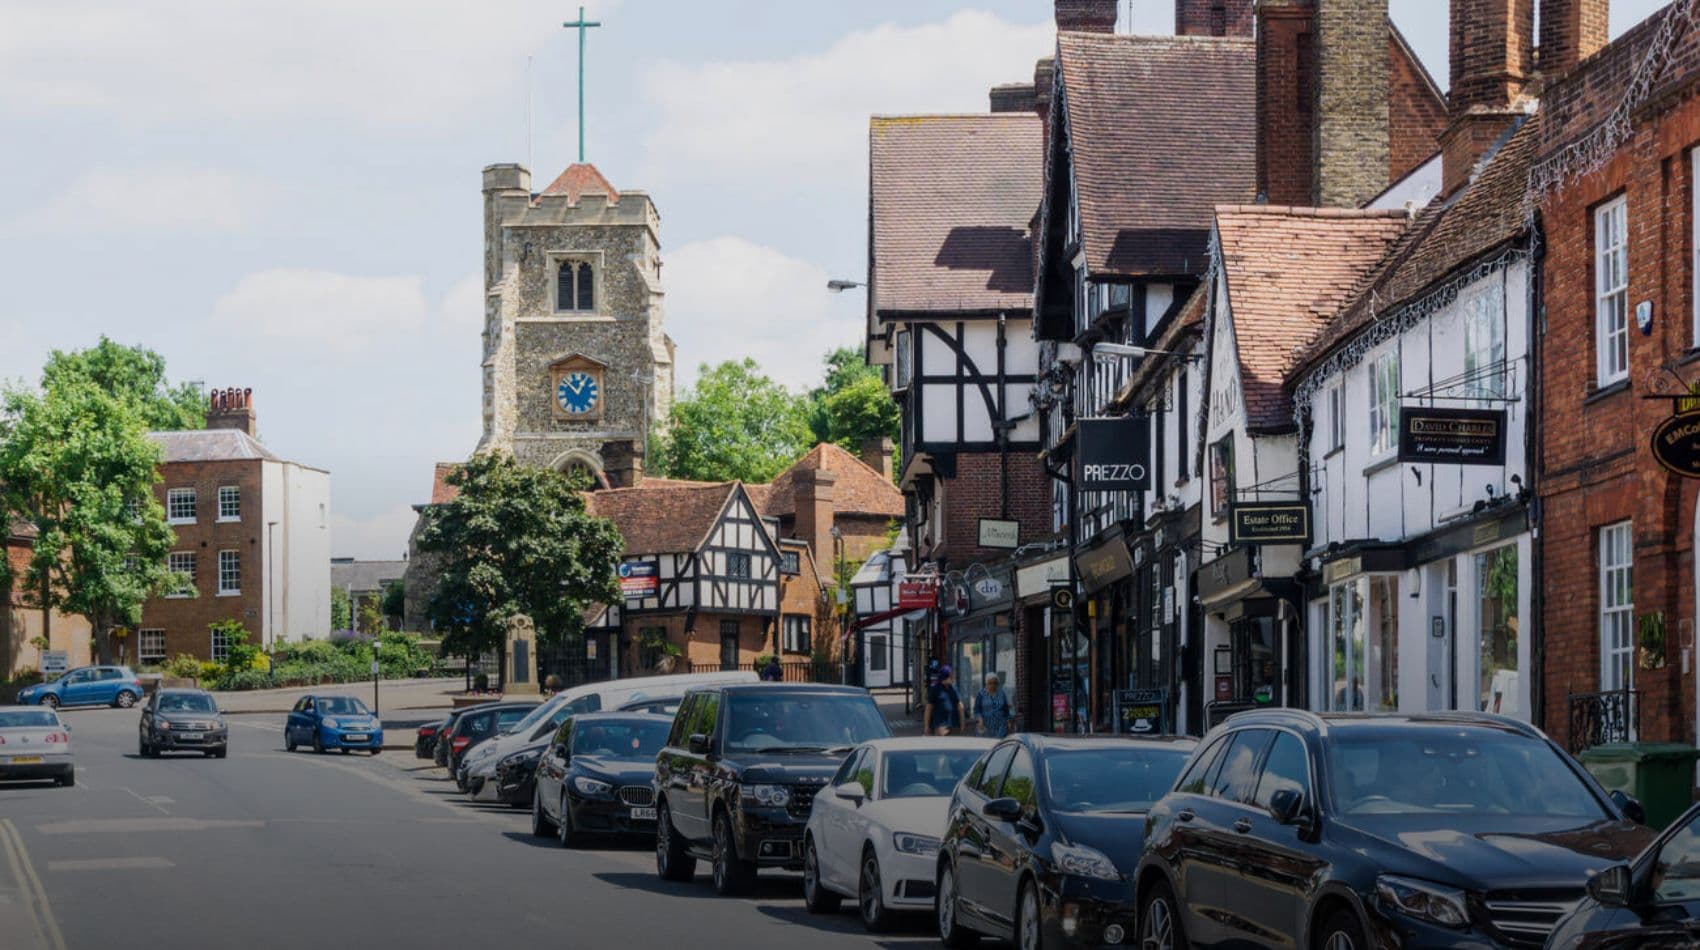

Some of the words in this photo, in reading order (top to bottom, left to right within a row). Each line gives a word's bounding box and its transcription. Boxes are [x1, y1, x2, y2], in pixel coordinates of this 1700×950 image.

[1084, 464, 1145, 482] PREZZO
[1243, 514, 1270, 525] Estate
[1271, 514, 1298, 524] Office
